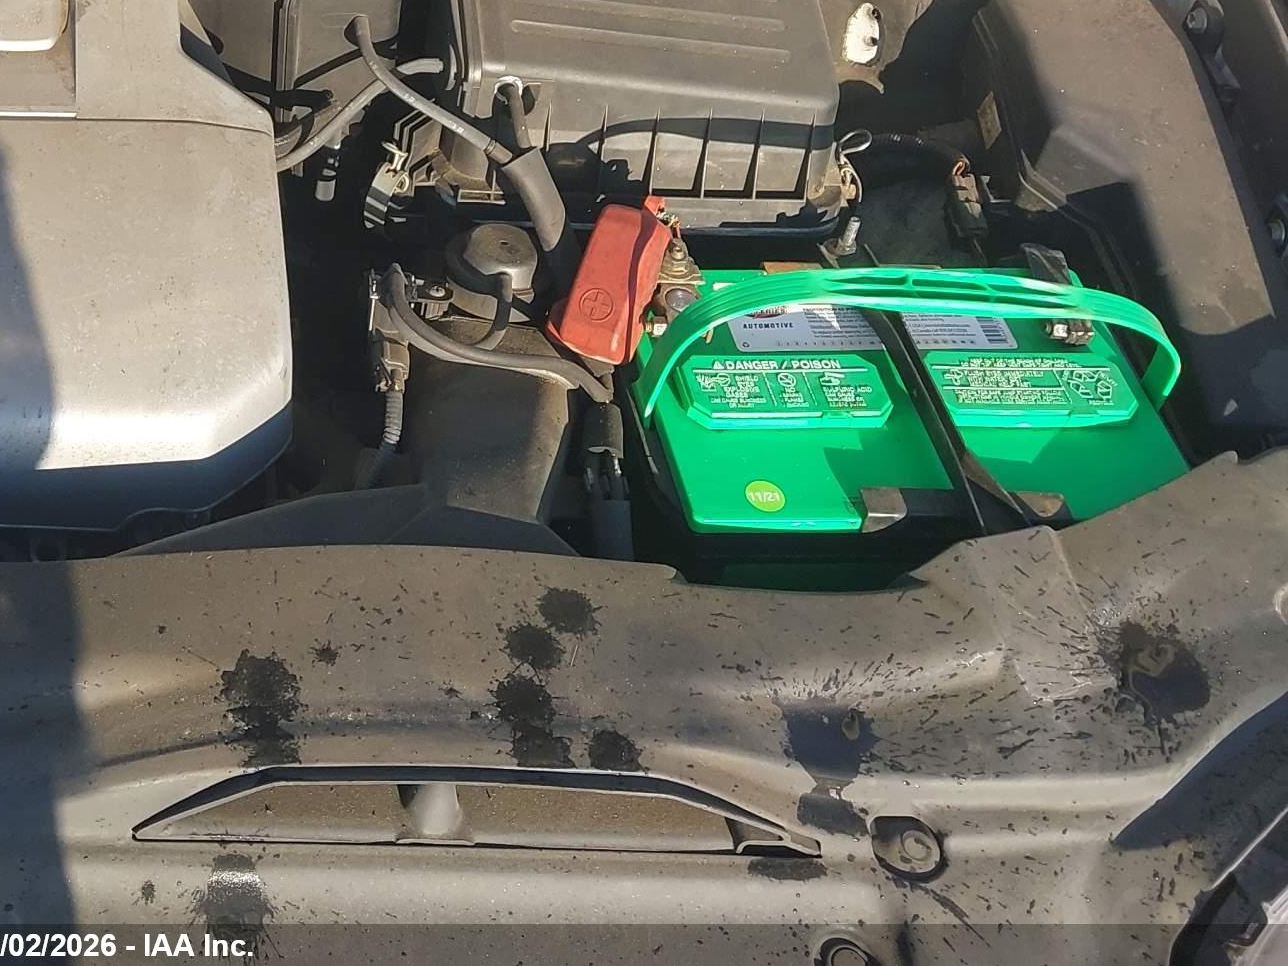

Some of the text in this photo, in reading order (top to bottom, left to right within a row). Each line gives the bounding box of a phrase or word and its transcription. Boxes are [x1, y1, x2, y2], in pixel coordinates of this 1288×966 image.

[726, 359, 841, 370] DANGER / POISON
[748, 491, 781, 502] 11/21
